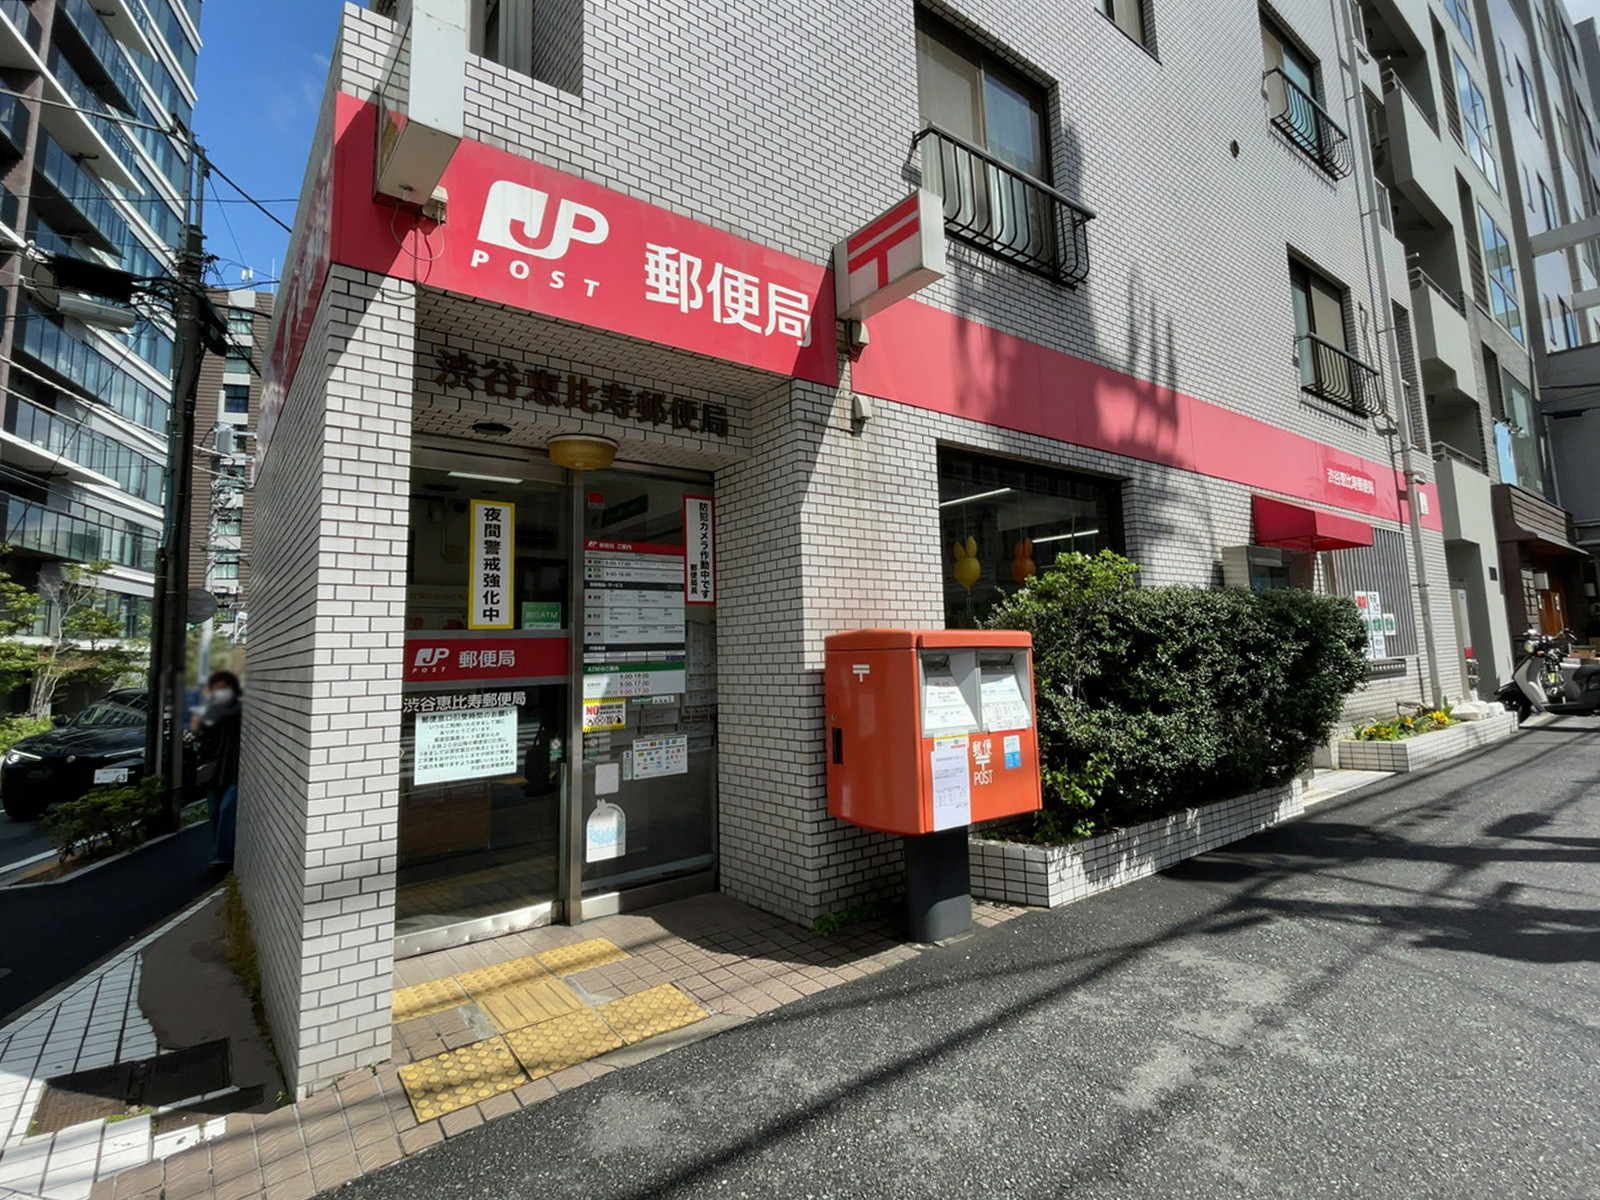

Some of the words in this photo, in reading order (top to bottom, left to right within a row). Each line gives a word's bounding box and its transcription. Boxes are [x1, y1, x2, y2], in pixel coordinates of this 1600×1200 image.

[470, 249, 600, 297] POST
[644, 242, 812, 347] 郵便局
[435, 349, 728, 437] 渋谷恵比寿郵便局
[482, 507, 502, 622] 夜間警戒強化中
[699, 502, 710, 599] 防犯カメラ作動中です
[690, 564, 698, 594] 郵便局長
[459, 650, 515, 668] 郵便局
[403, 691, 526, 713] 渋谷恵比寿郵便局
[586, 705, 599, 716] NO
[972, 739, 992, 757] 郵便
[973, 770, 993, 786] POST
